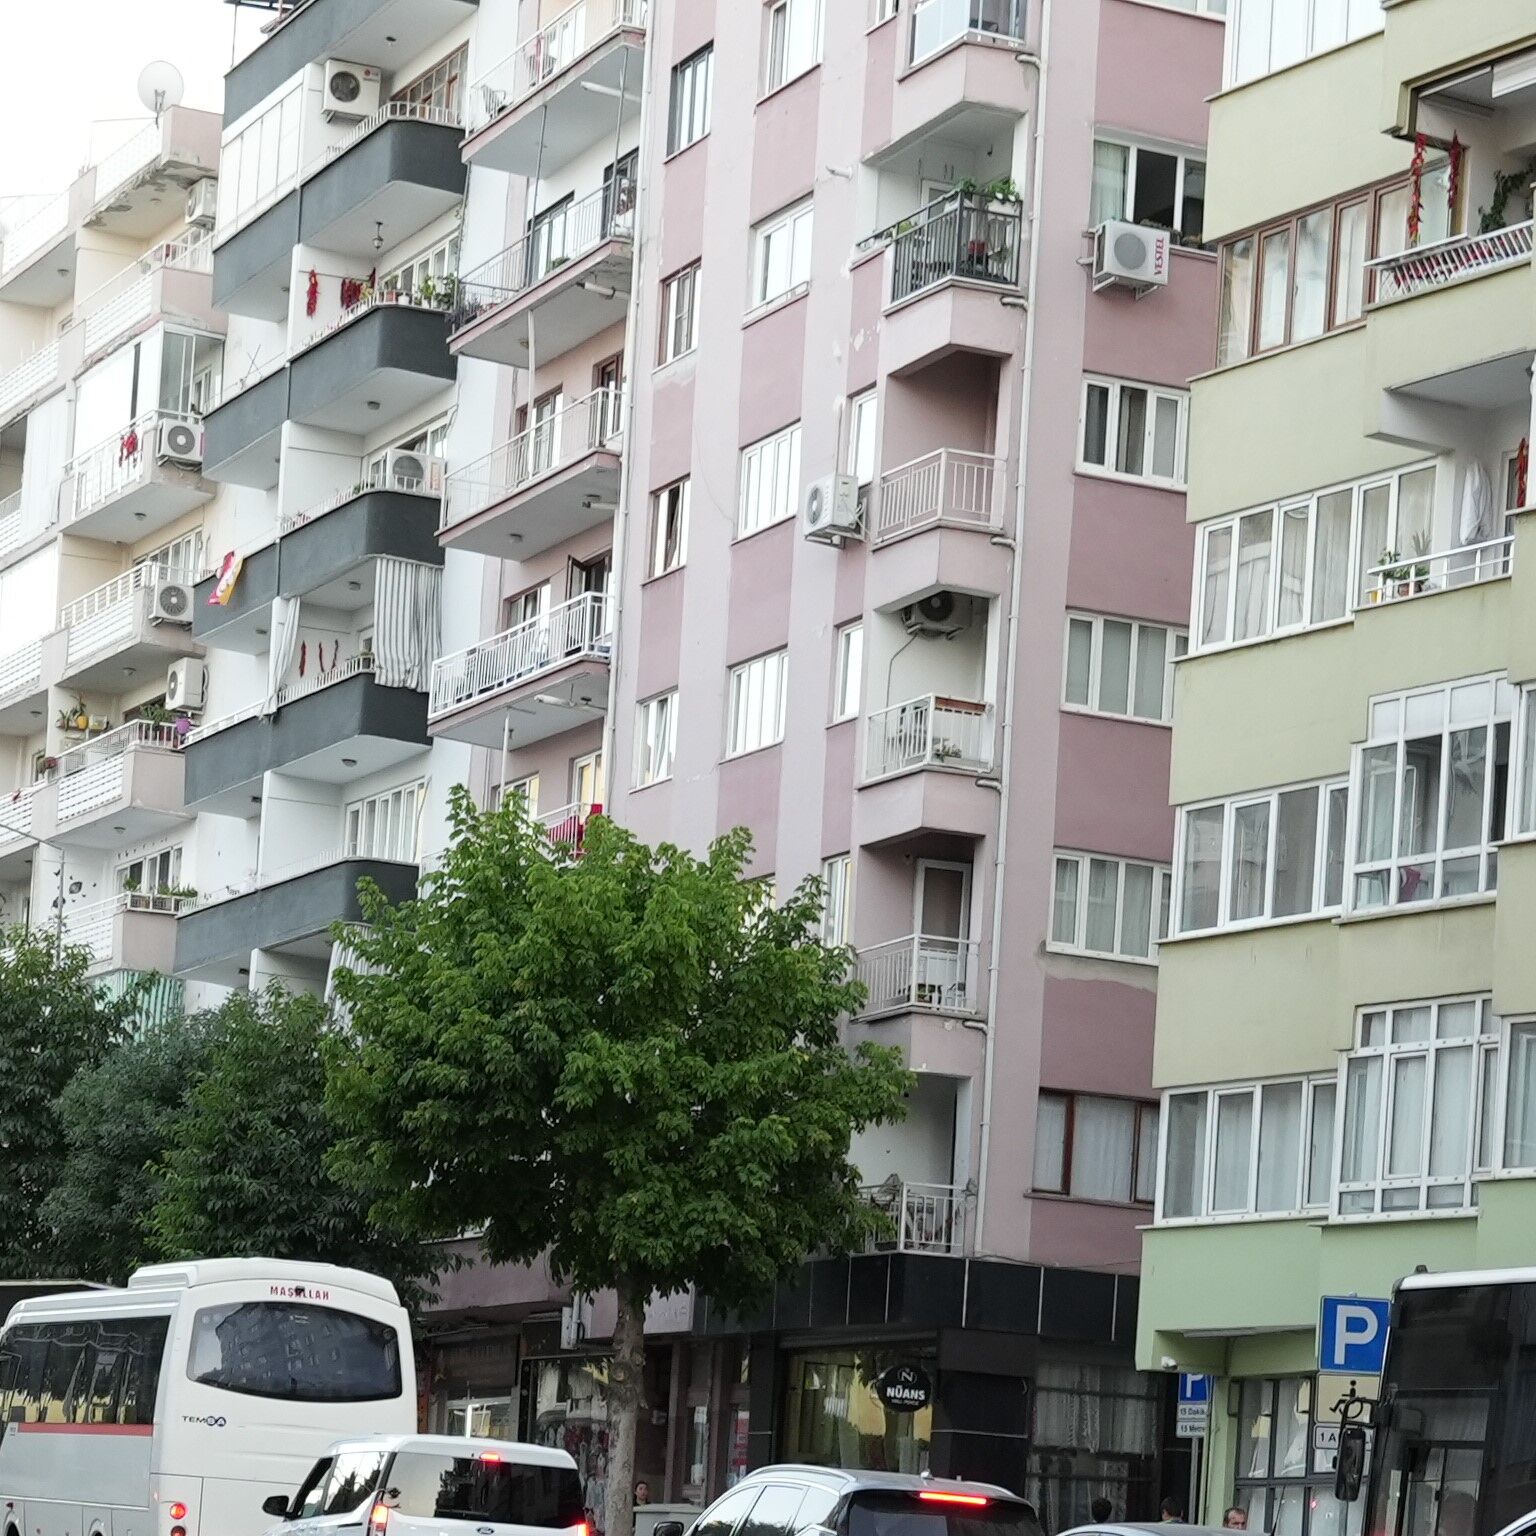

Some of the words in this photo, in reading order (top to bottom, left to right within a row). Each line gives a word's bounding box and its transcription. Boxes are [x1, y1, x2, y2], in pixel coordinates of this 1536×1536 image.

[1154, 237, 1164, 275] VESTEL
[1334, 1304, 1379, 1365] P
[886, 1384, 926, 1401] NÜANS
